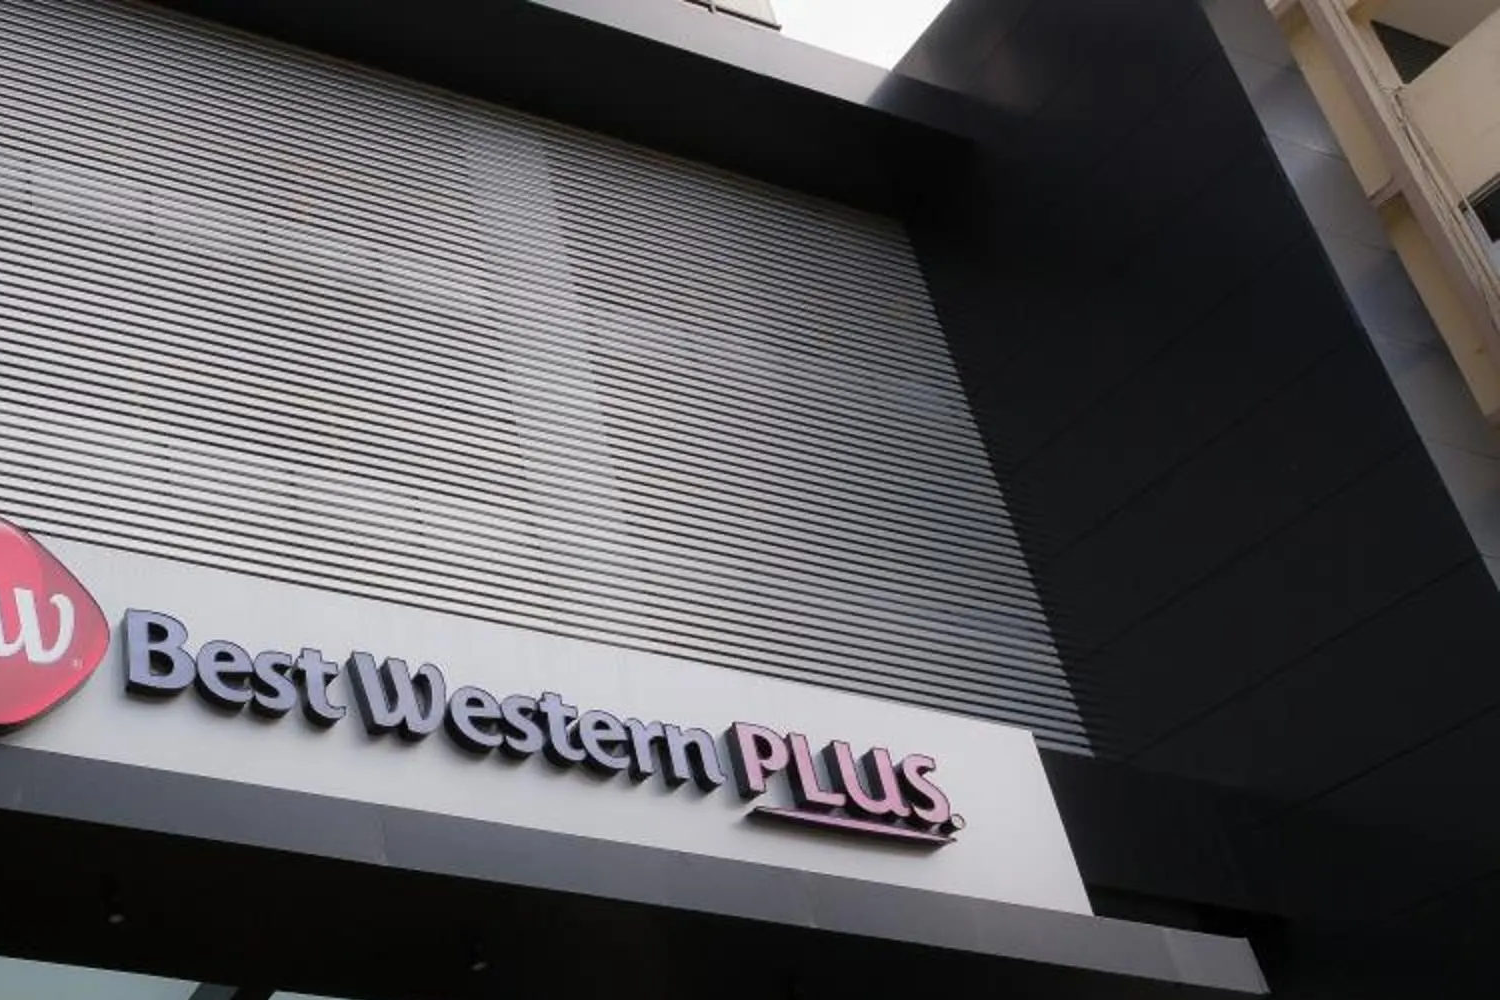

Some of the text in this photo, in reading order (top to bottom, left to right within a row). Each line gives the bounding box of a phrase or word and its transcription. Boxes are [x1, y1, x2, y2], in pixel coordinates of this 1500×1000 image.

[125, 608, 952, 828] Best Western PLUS
